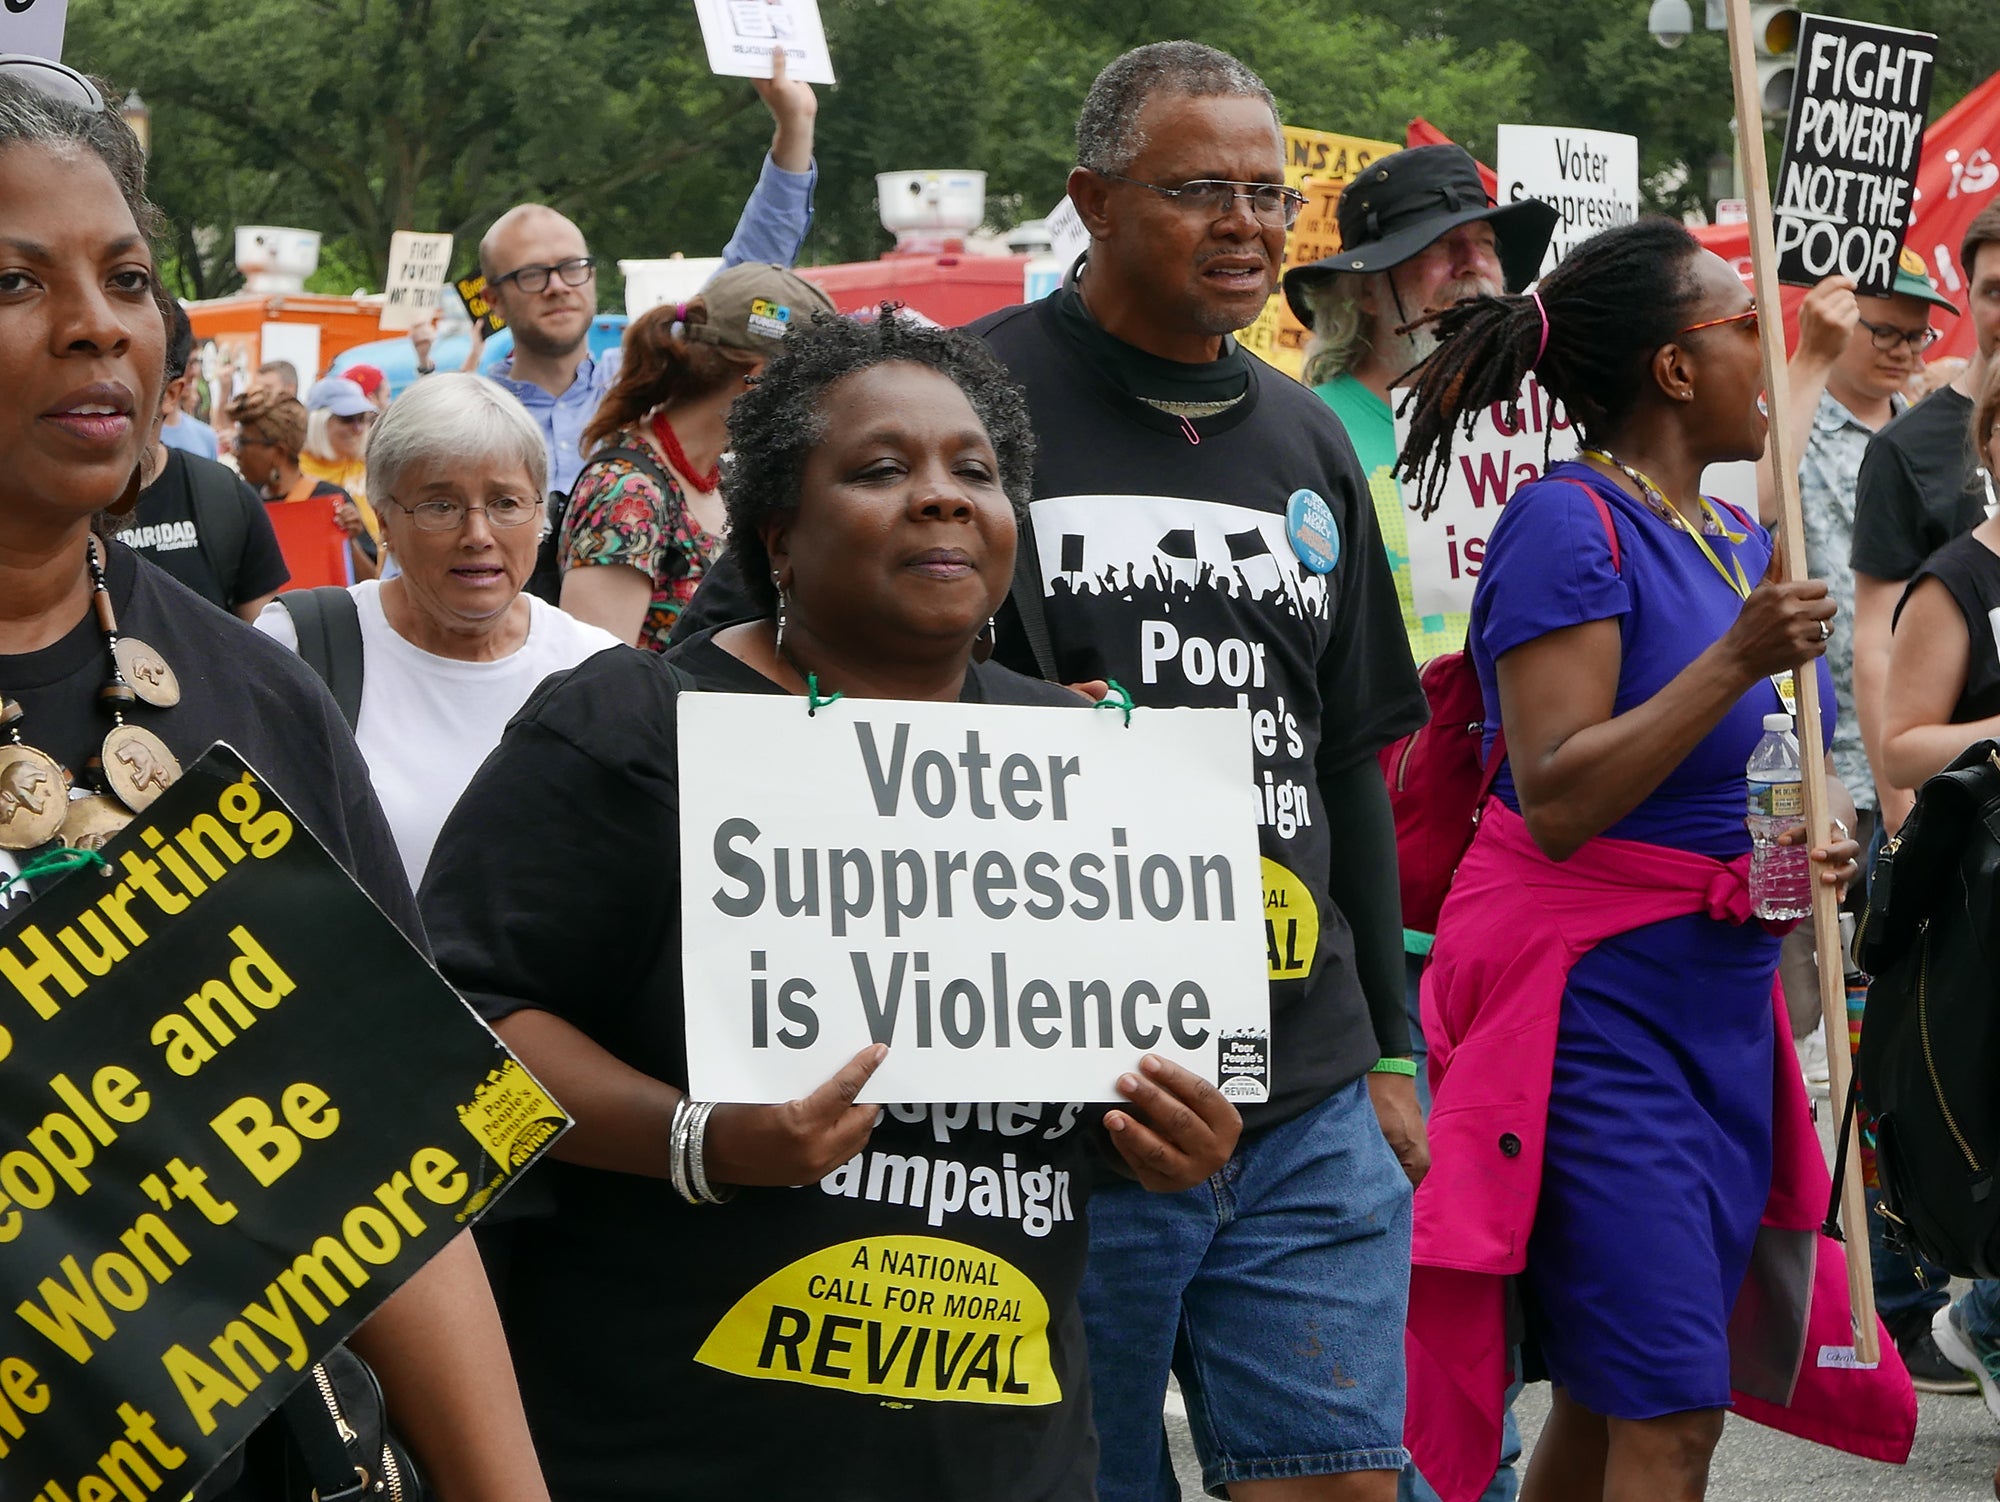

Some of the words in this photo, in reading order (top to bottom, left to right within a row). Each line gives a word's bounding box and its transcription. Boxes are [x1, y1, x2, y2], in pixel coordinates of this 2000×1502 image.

[1807, 31, 1934, 107] FIGHT
[1285, 139, 1371, 175] NSAS
[1555, 137, 1608, 184] Voter
[1795, 96, 1922, 173] POVERTY
[1778, 161, 1858, 222] NOT
[1857, 172, 1910, 228] THE
[1775, 216, 1898, 289] POOR
[116, 521, 196, 548] DARIDAD
[1141, 620, 1266, 688] Poor
[854, 722, 1081, 820] Voter
[0, 771, 293, 1021] Hurting
[711, 818, 1236, 938] Suppression
[151, 925, 297, 1076] and
[751, 951, 820, 1049] is
[850, 951, 1211, 1050] Violence
[1221, 1064, 1265, 1076] Campaign
[1222, 1052, 1264, 1065] People's
[1231, 1042, 1255, 1053] Poor
[482, 1089, 532, 1137] People's
[483, 1088, 514, 1117] Poor
[490, 1097, 543, 1148] Campaign
[1224, 1086, 1261, 1096] REVIVAL
[15, 1158, 239, 1364] Won't
[209, 1083, 340, 1188] Be
[789, 1152, 1074, 1237] ampaign
[162, 1147, 469, 1436] Anymore
[808, 1274, 873, 1307] CALL
[884, 1287, 934, 1314] FOR
[944, 1295, 1022, 1322] MORAL
[851, 1246, 869, 1270] A
[881, 1249, 999, 1286] NATIONAL
[757, 1305, 1030, 1395] REVIVAL
